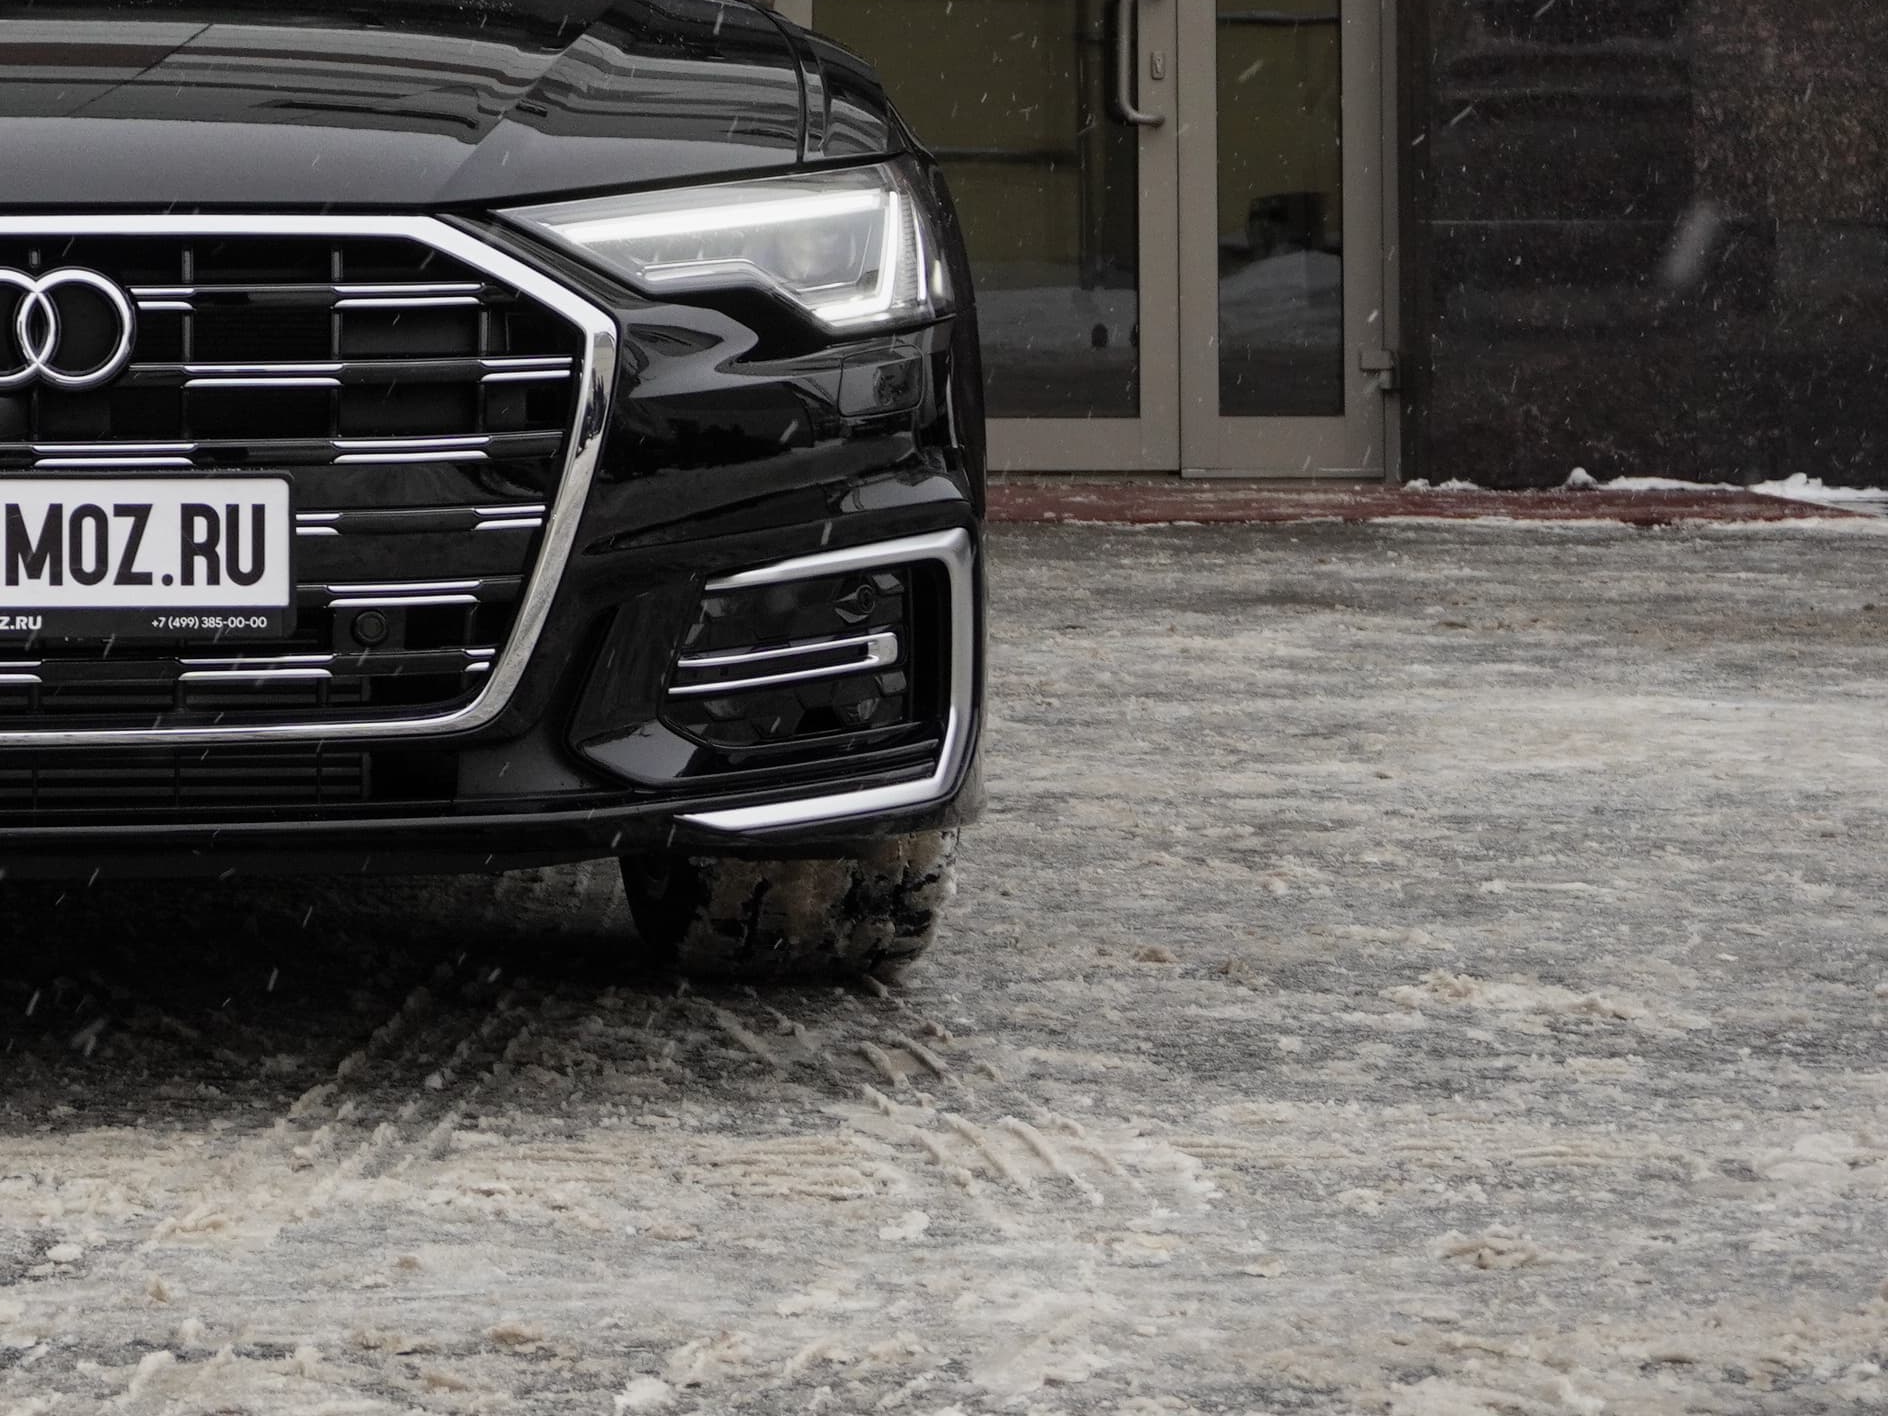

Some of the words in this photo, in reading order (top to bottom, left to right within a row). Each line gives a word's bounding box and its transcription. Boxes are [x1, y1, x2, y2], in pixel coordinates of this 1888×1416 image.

[151, 616, 166, 628] +7
[168, 615, 199, 630] (499)
[201, 616, 267, 628] 385-00-00
